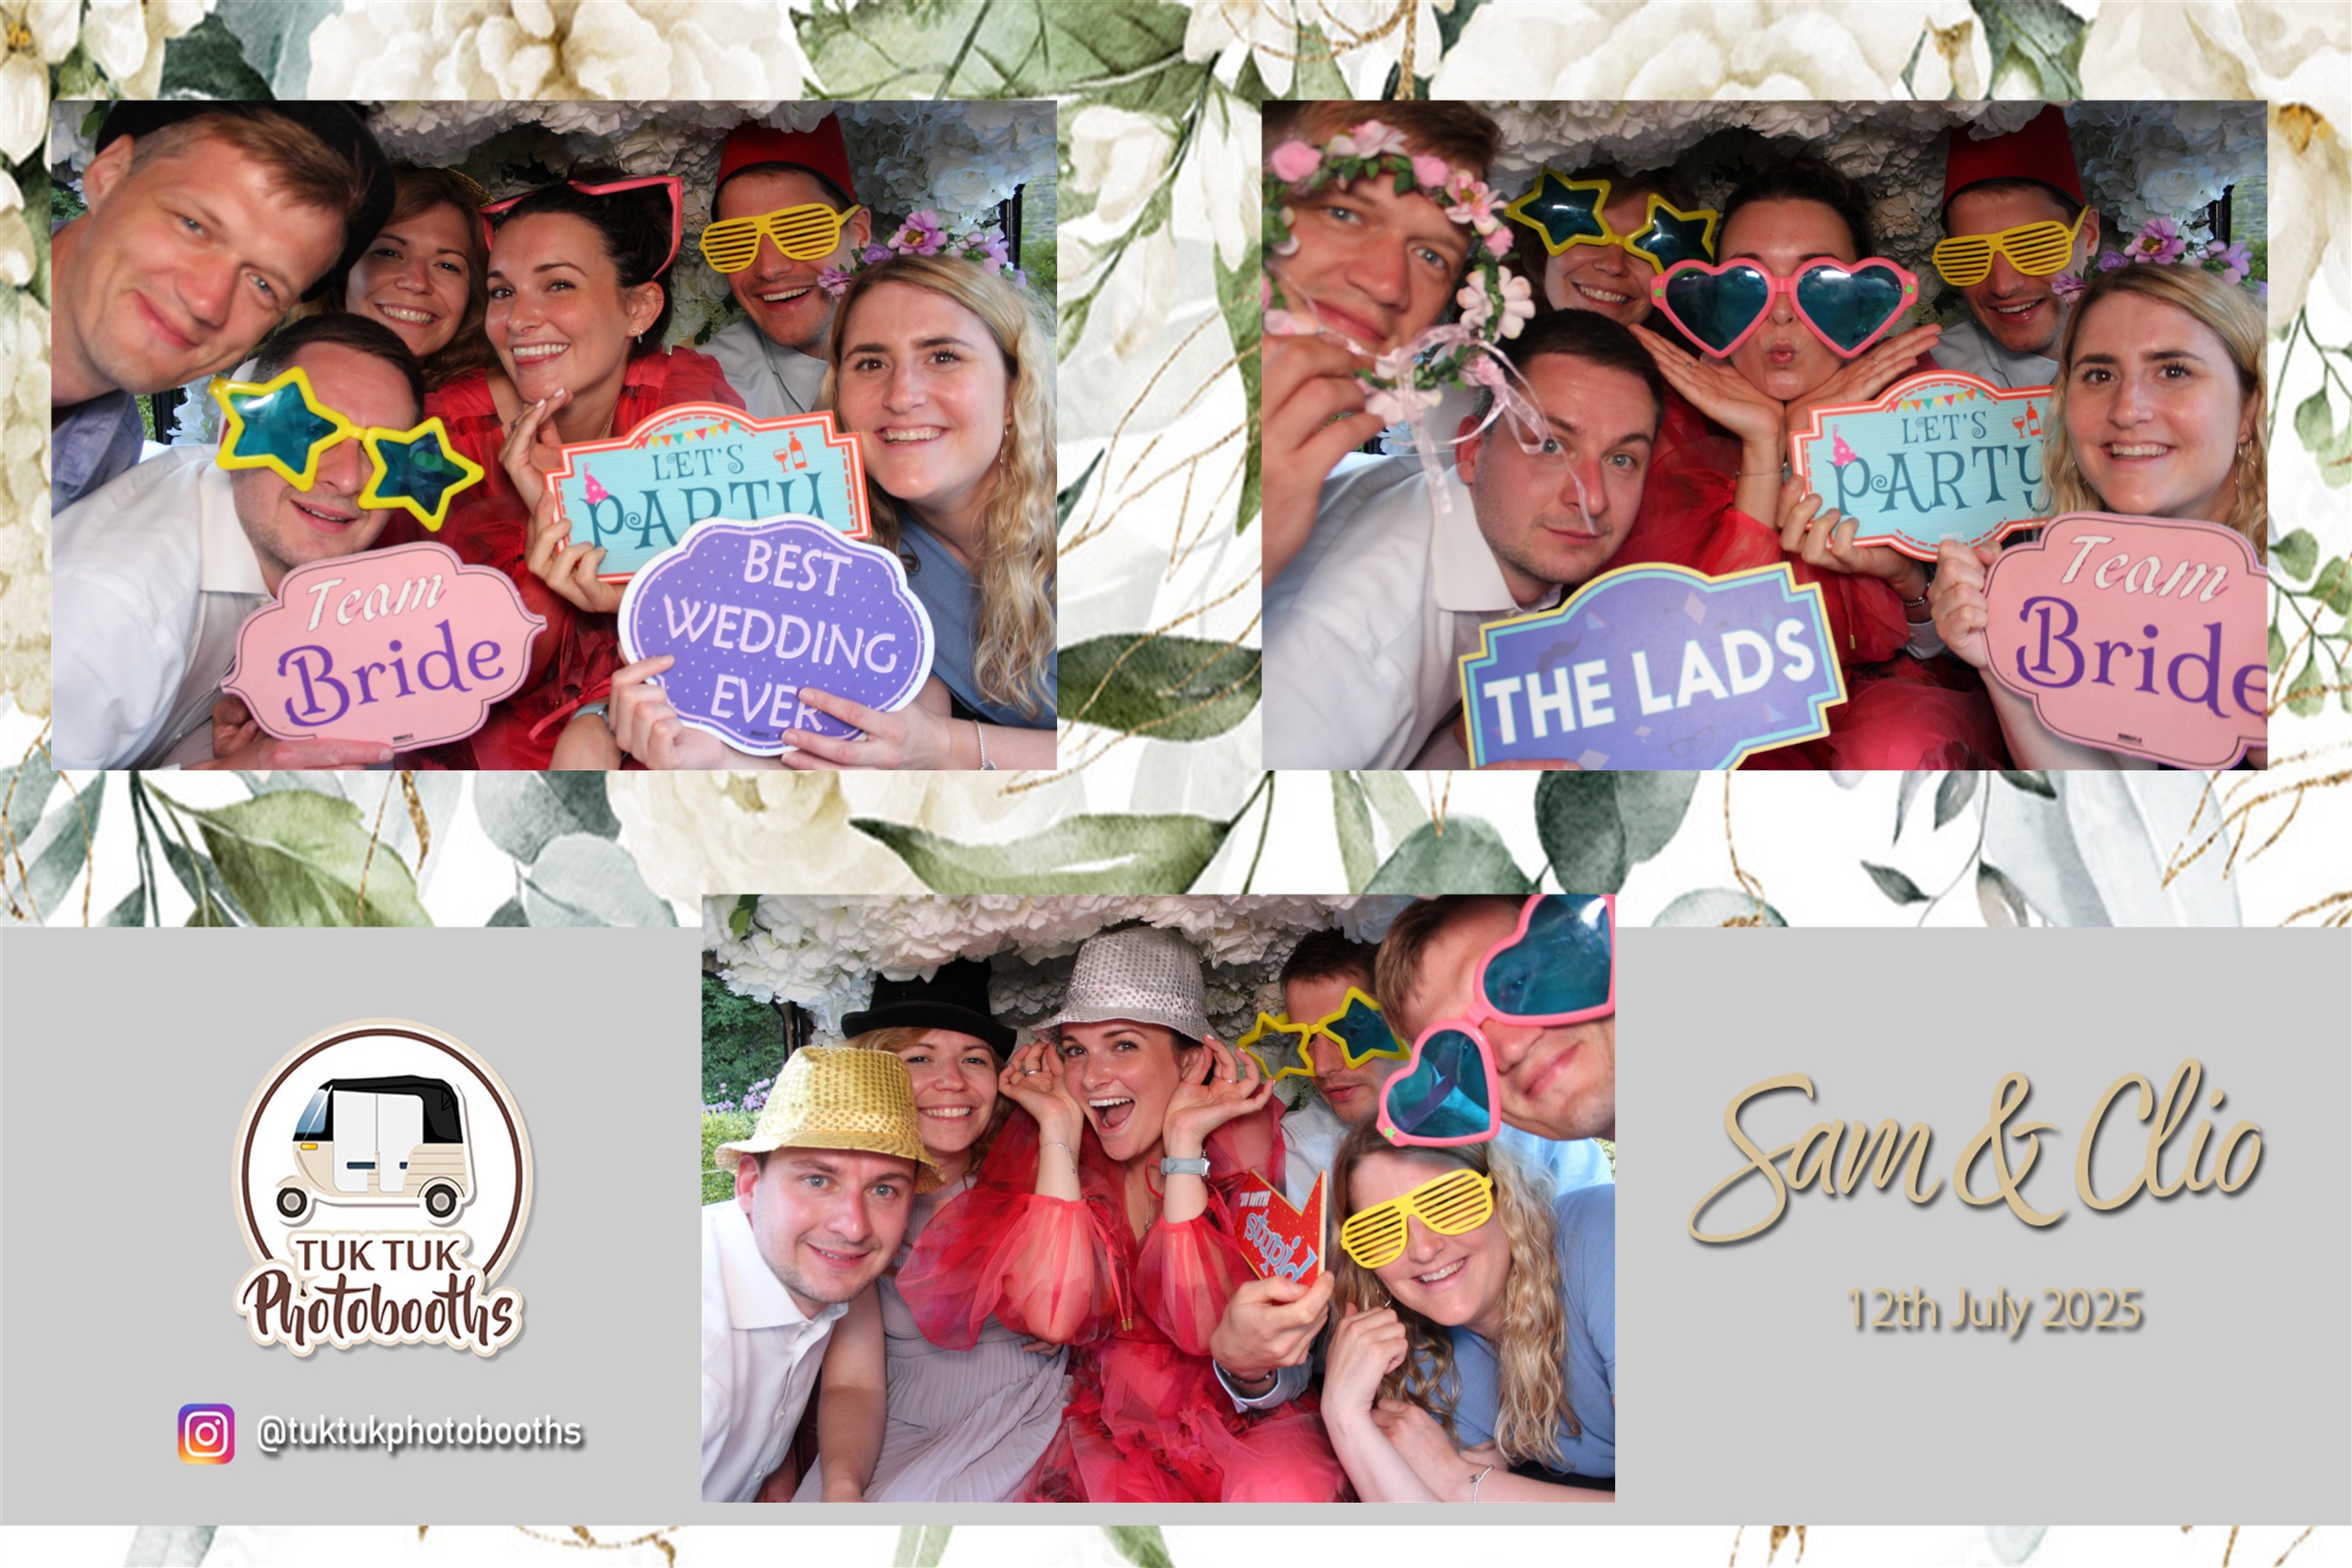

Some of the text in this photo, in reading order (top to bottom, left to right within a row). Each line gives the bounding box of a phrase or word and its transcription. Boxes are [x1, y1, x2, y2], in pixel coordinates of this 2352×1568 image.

[1901, 410, 1987, 445] LET'S
[652, 444, 744, 482] LET'S
[306, 573, 447, 632] Team
[743, 539, 853, 597] BEST
[2061, 534, 2230, 603] Team
[663, 594, 897, 674] WEDDING
[2015, 595, 2268, 719] Bride
[278, 619, 505, 727] Bride
[1483, 618, 1816, 745] THE LADS
